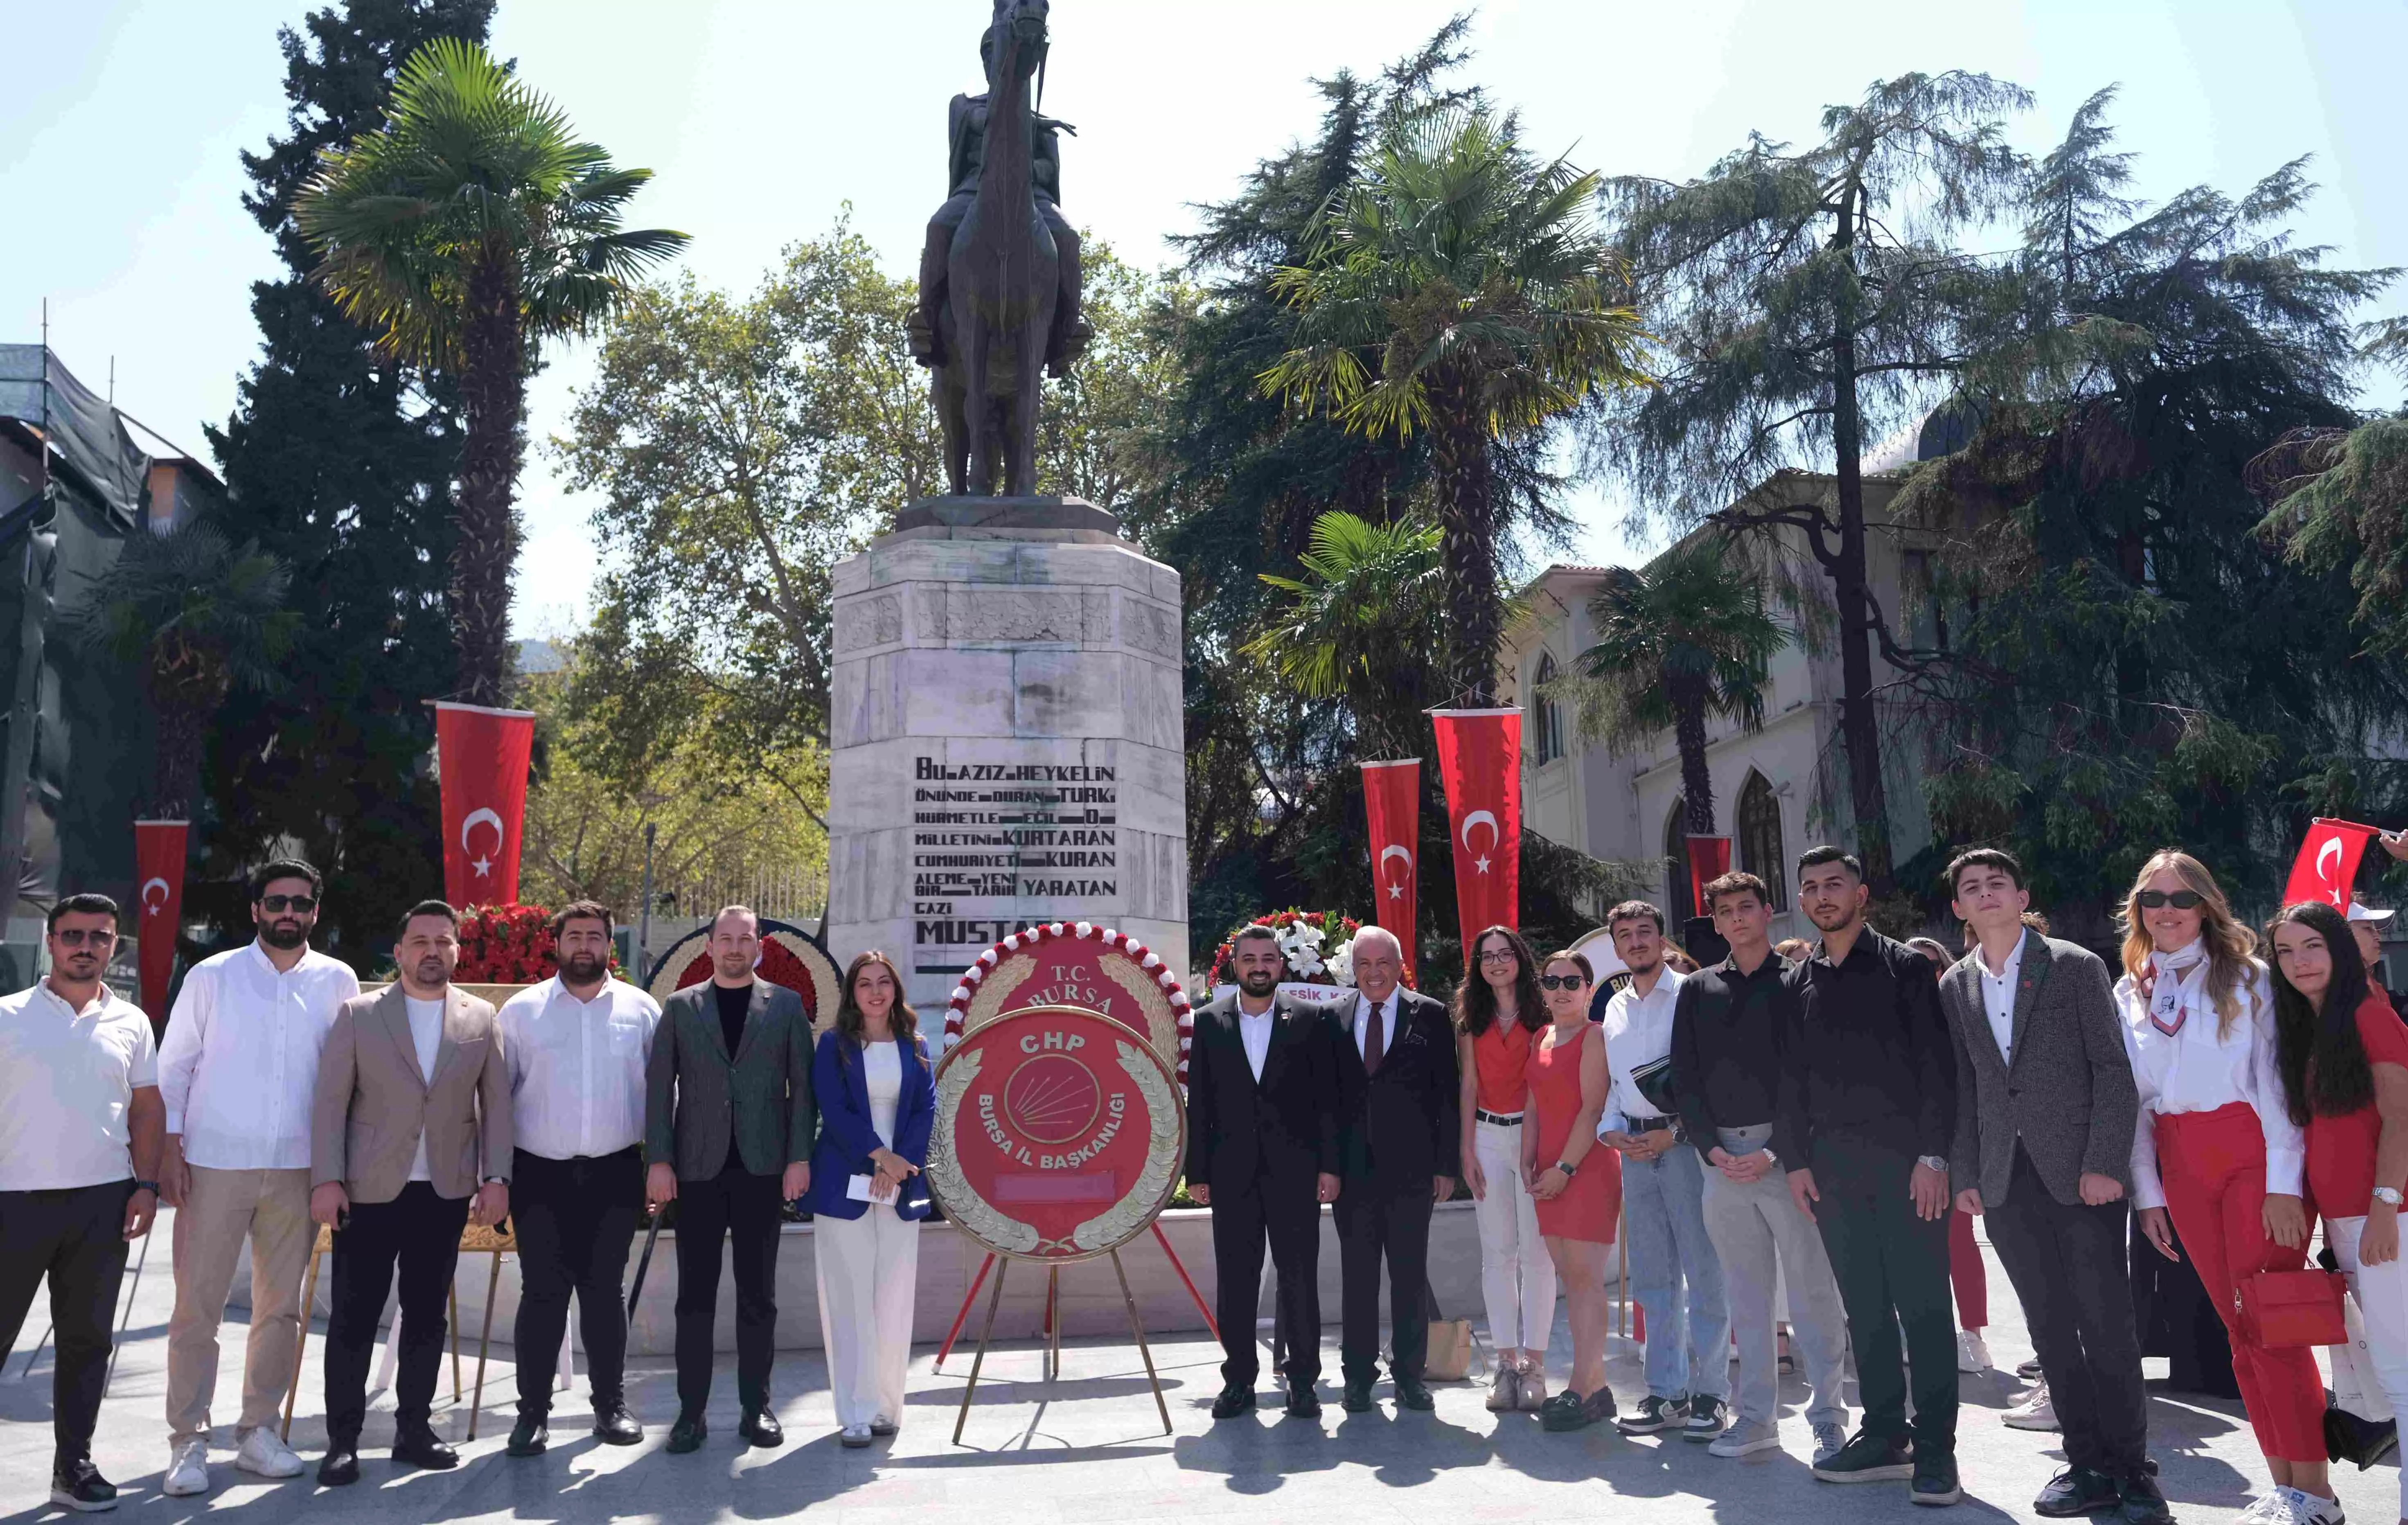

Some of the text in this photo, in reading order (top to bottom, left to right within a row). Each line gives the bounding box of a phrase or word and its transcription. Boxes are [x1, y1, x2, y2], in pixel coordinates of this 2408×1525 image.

[958, 765, 1005, 780] AZİZ
[1017, 766, 1114, 781] HEYKELİN
[993, 791, 1044, 802] DURAN
[915, 812, 998, 823] HÜRMETLE
[1086, 809, 1098, 824] O
[1003, 830, 1114, 845] KURTARAN
[1046, 852, 1115, 867] KURAN
[915, 873, 967, 884] ALEME
[915, 885, 940, 896] BİR
[1024, 880, 1116, 896] YARATAN
[1051, 966, 1090, 981] T.C.
[1027, 983, 1111, 1014] BURSA
[1020, 1032, 1085, 1053] CHP
[979, 1093, 1124, 1169] BURSA İL BAŞKANLIĞI
